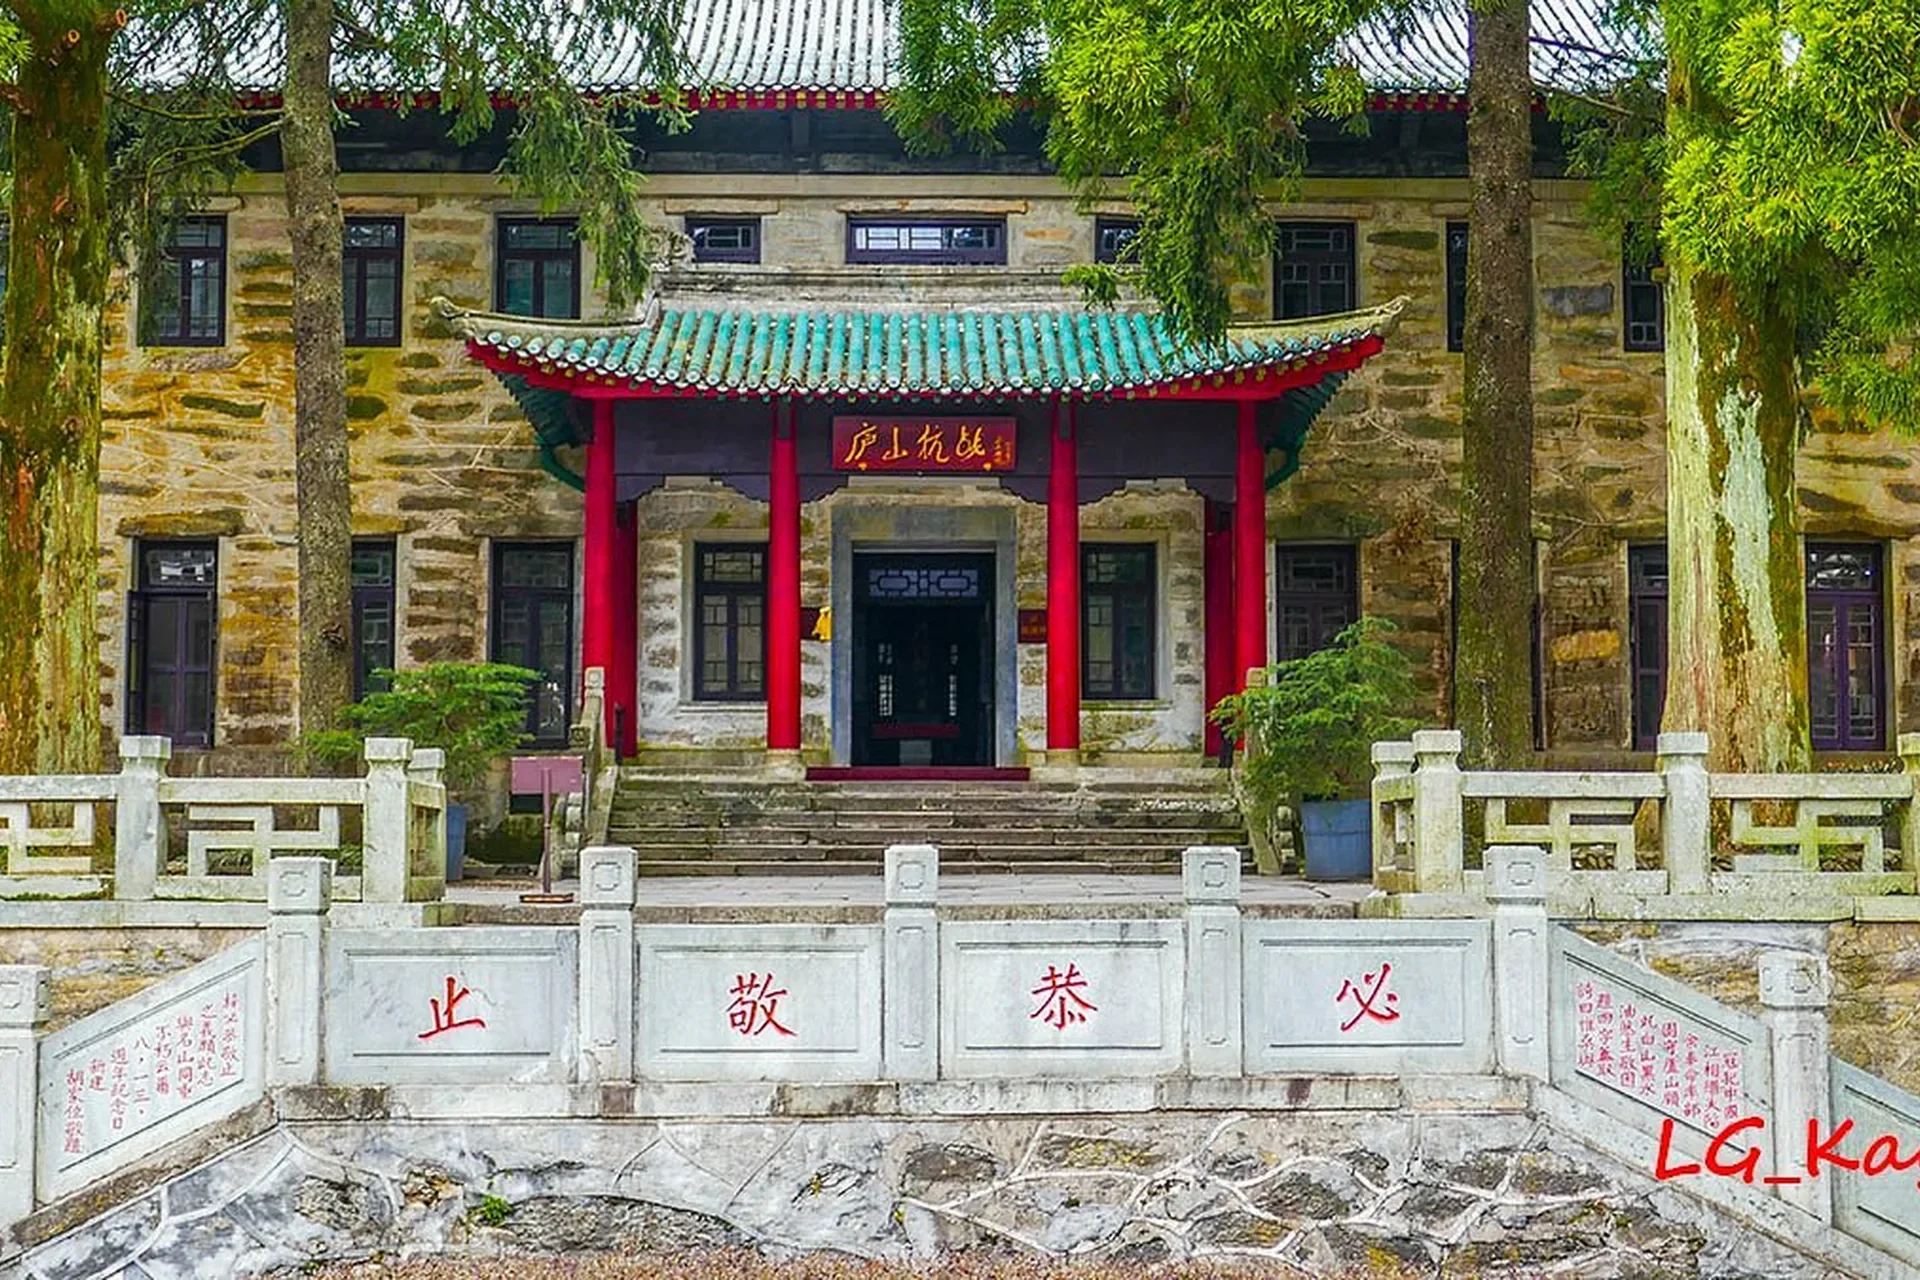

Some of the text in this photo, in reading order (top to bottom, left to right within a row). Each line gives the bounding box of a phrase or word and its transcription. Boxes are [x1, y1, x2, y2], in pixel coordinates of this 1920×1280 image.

[418, 976, 486, 1040] 止
[727, 972, 797, 1036] 敬
[1031, 964, 1097, 1030] 恭
[1336, 964, 1400, 1032] 必
